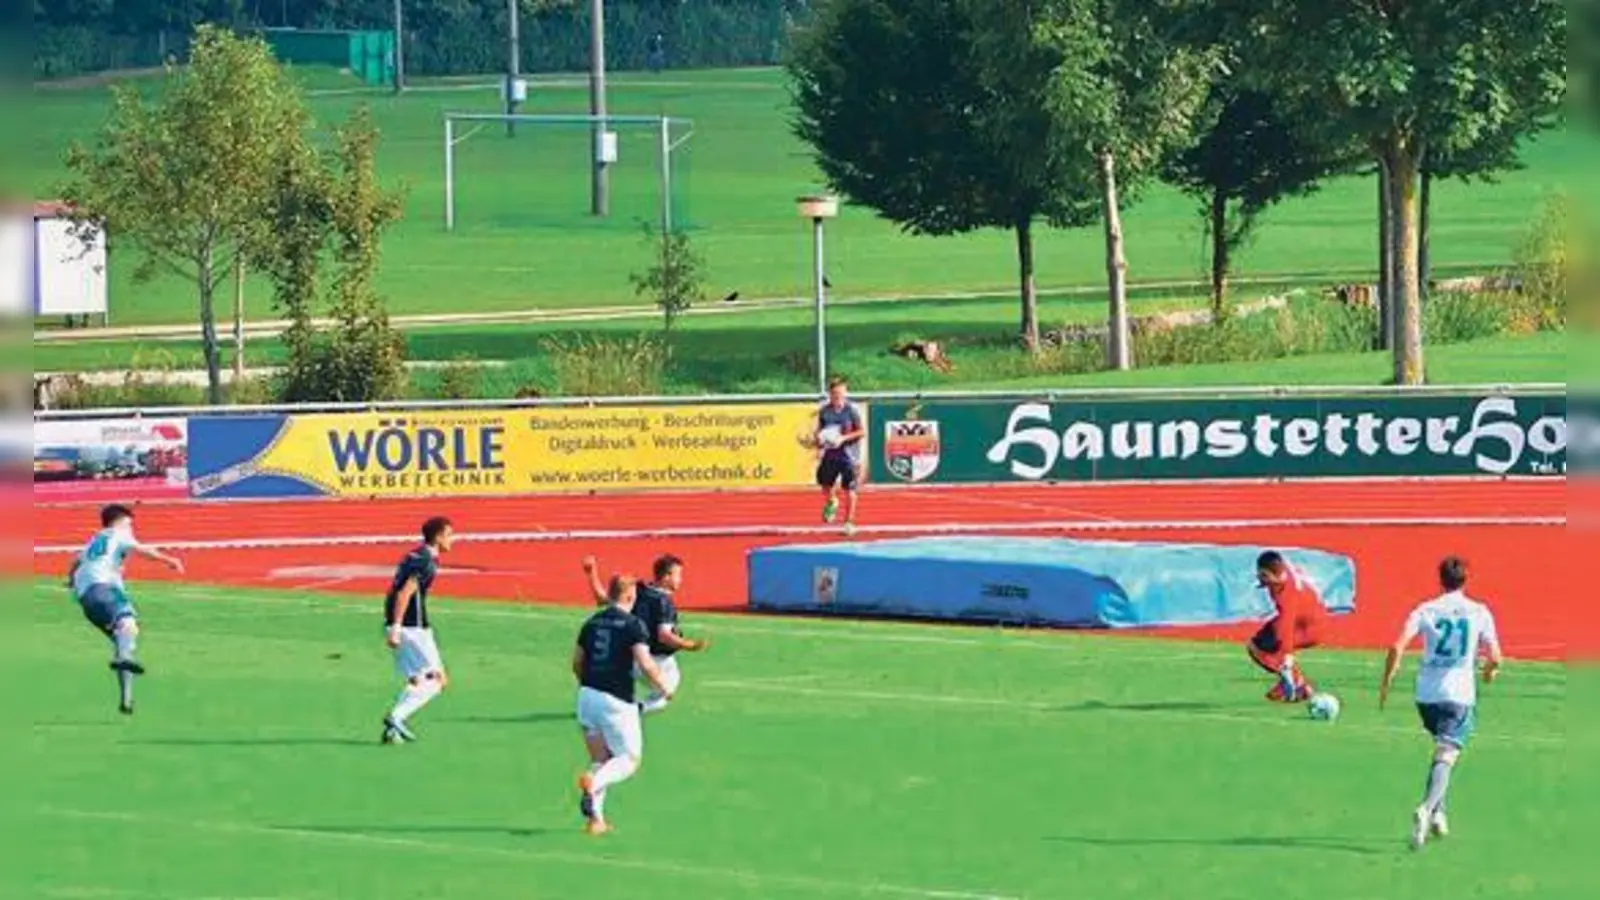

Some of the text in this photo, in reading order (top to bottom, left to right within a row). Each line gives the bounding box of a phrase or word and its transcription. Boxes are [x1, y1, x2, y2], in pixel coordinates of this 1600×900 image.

[529, 412, 650, 432] Bandenwerbung
[663, 411, 776, 430] Beschriftungen
[327, 418, 505, 472] WÖRLE
[548, 434, 636, 453] Digitaldruck
[652, 432, 758, 451] Werbeanlagen
[987, 402, 1460, 479] Haunstetter
[339, 472, 506, 488] WERBETECHNIK
[530, 463, 773, 485] www.woerle-werbetechnik.de
[593, 629, 612, 661] 3
[1434, 617, 1470, 657] 21
